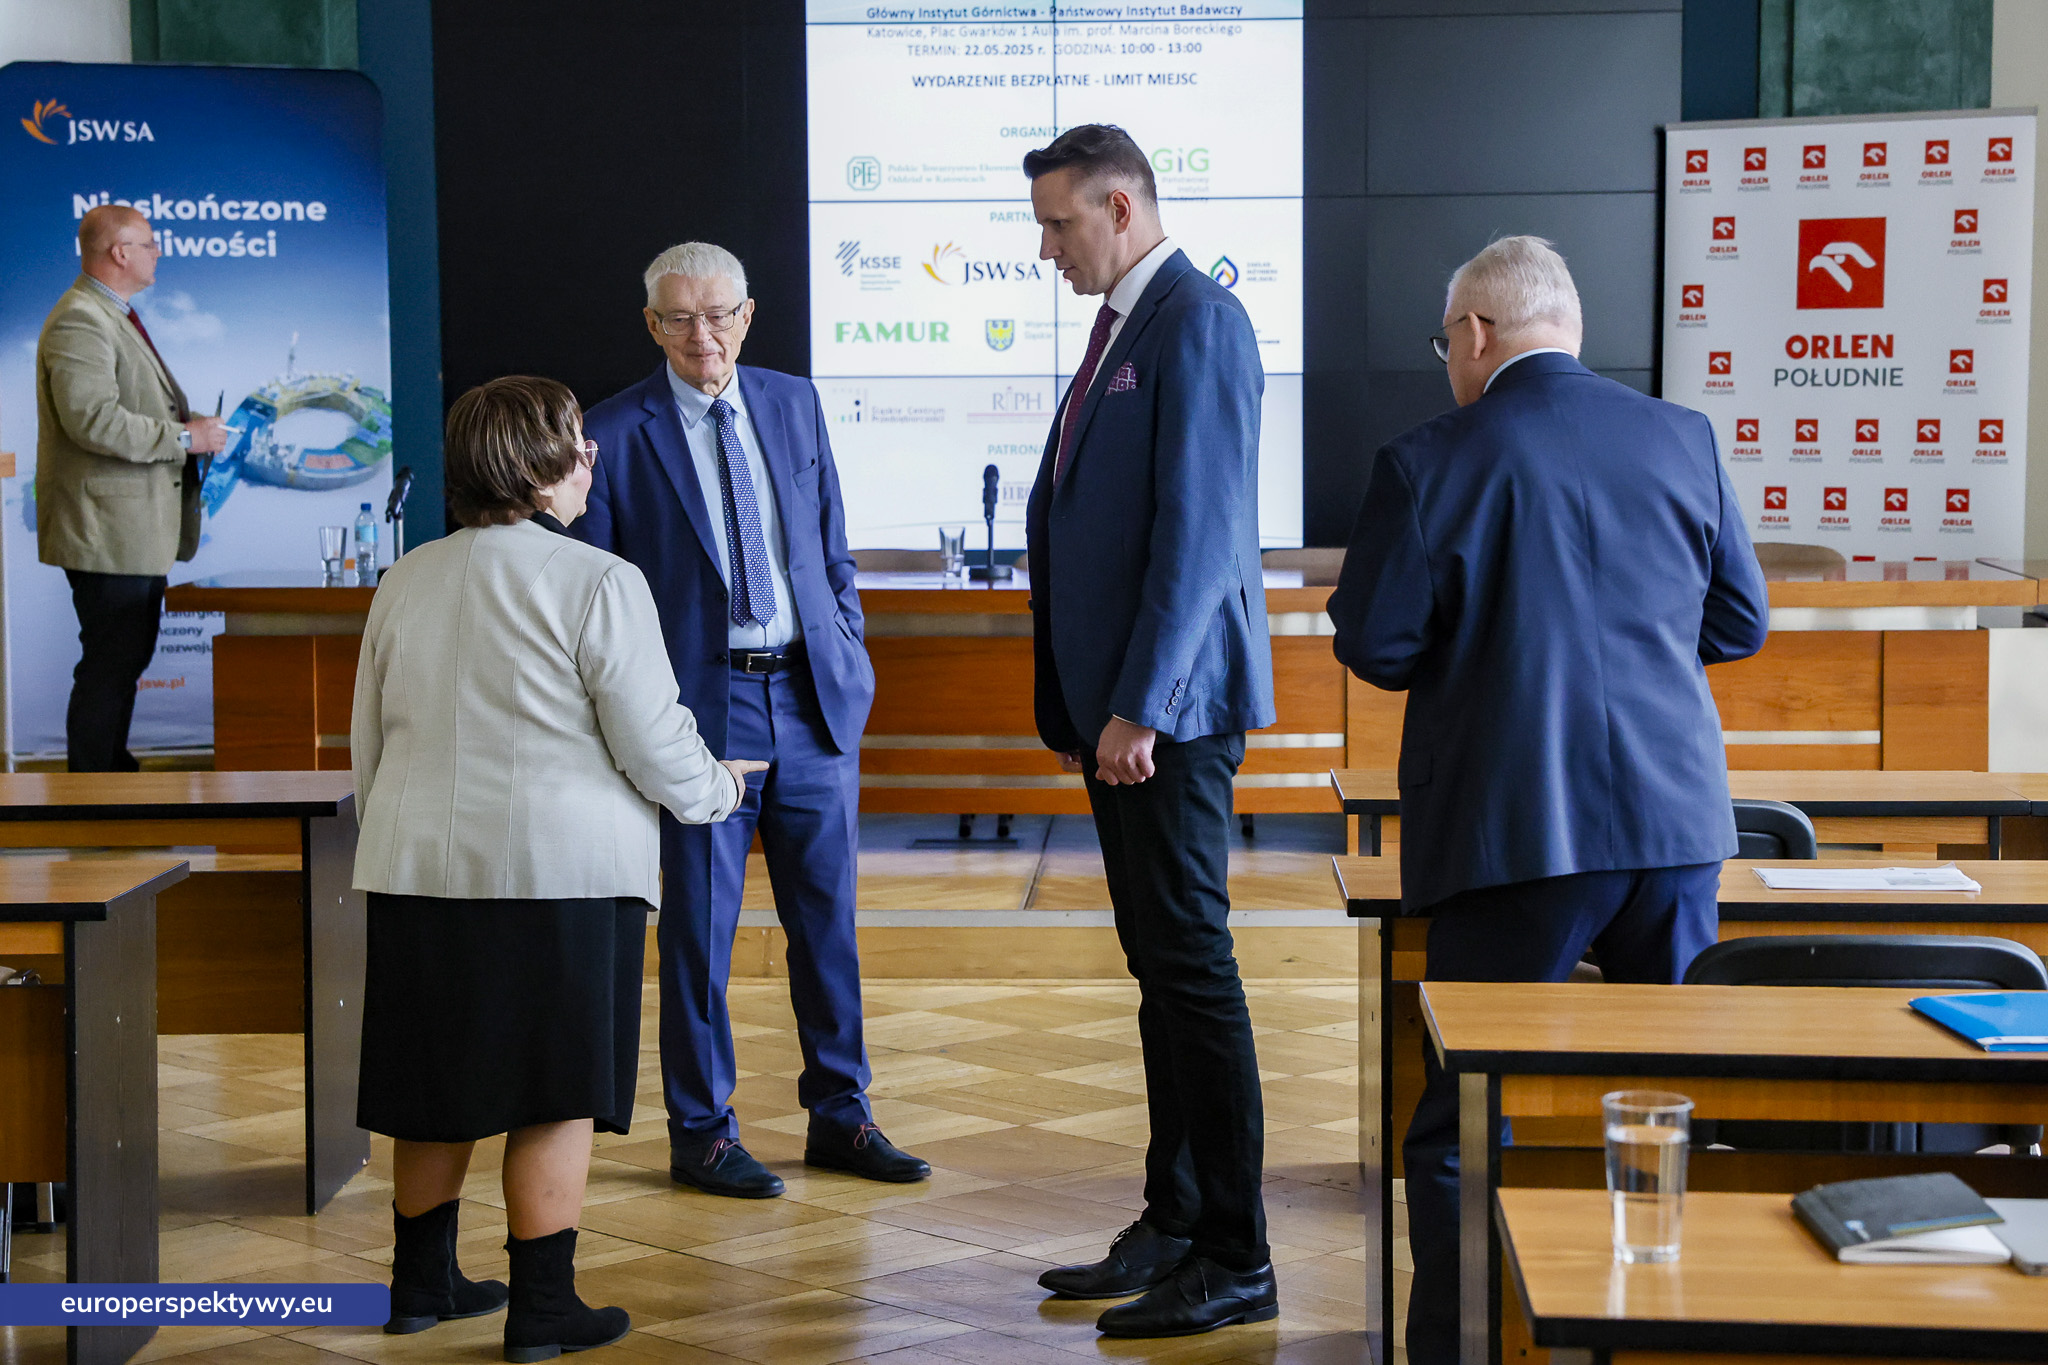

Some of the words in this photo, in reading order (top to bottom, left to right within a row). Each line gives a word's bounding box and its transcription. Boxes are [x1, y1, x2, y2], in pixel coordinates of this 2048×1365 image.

[866, 7, 915, 21] Główny
[918, 7, 968, 20] Instytut
[971, 6, 1037, 18] Górnictwa
[1050, 5, 1122, 19] Państwowy
[1126, 5, 1176, 18] Instytut
[1180, 4, 1242, 17] Badawczy
[866, 26, 927, 39] Katowice,
[930, 26, 955, 37] Plac
[958, 26, 1016, 37] Gwarków
[1087, 24, 1115, 38] prof.
[1119, 24, 1169, 36] Marcina
[1173, 23, 1242, 36] Boreckiego
[907, 45, 960, 56] TERMIN:
[965, 44, 1034, 56] 22.05.2025
[1054, 43, 1117, 55] GODZINA:
[1121, 43, 1155, 54] 10:00
[1168, 42, 1203, 54] 13:00
[912, 75, 1006, 88] WYDARZENIE
[1011, 74, 1090, 87] BEZPŁATNE
[1104, 74, 1143, 86] LIMIT
[1147, 73, 1198, 86] MIEJSC
[68, 119, 120, 145] JSW
[124, 121, 155, 142] SA
[990, 211, 1036, 223] PARTN
[860, 256, 901, 269] KSSE
[962, 261, 1011, 285] JSW
[1014, 262, 1041, 281] SA
[835, 322, 949, 343] FAMUR
[1785, 334, 1894, 359] ORLEN
[1774, 367, 1904, 387] POŁUDNIE
